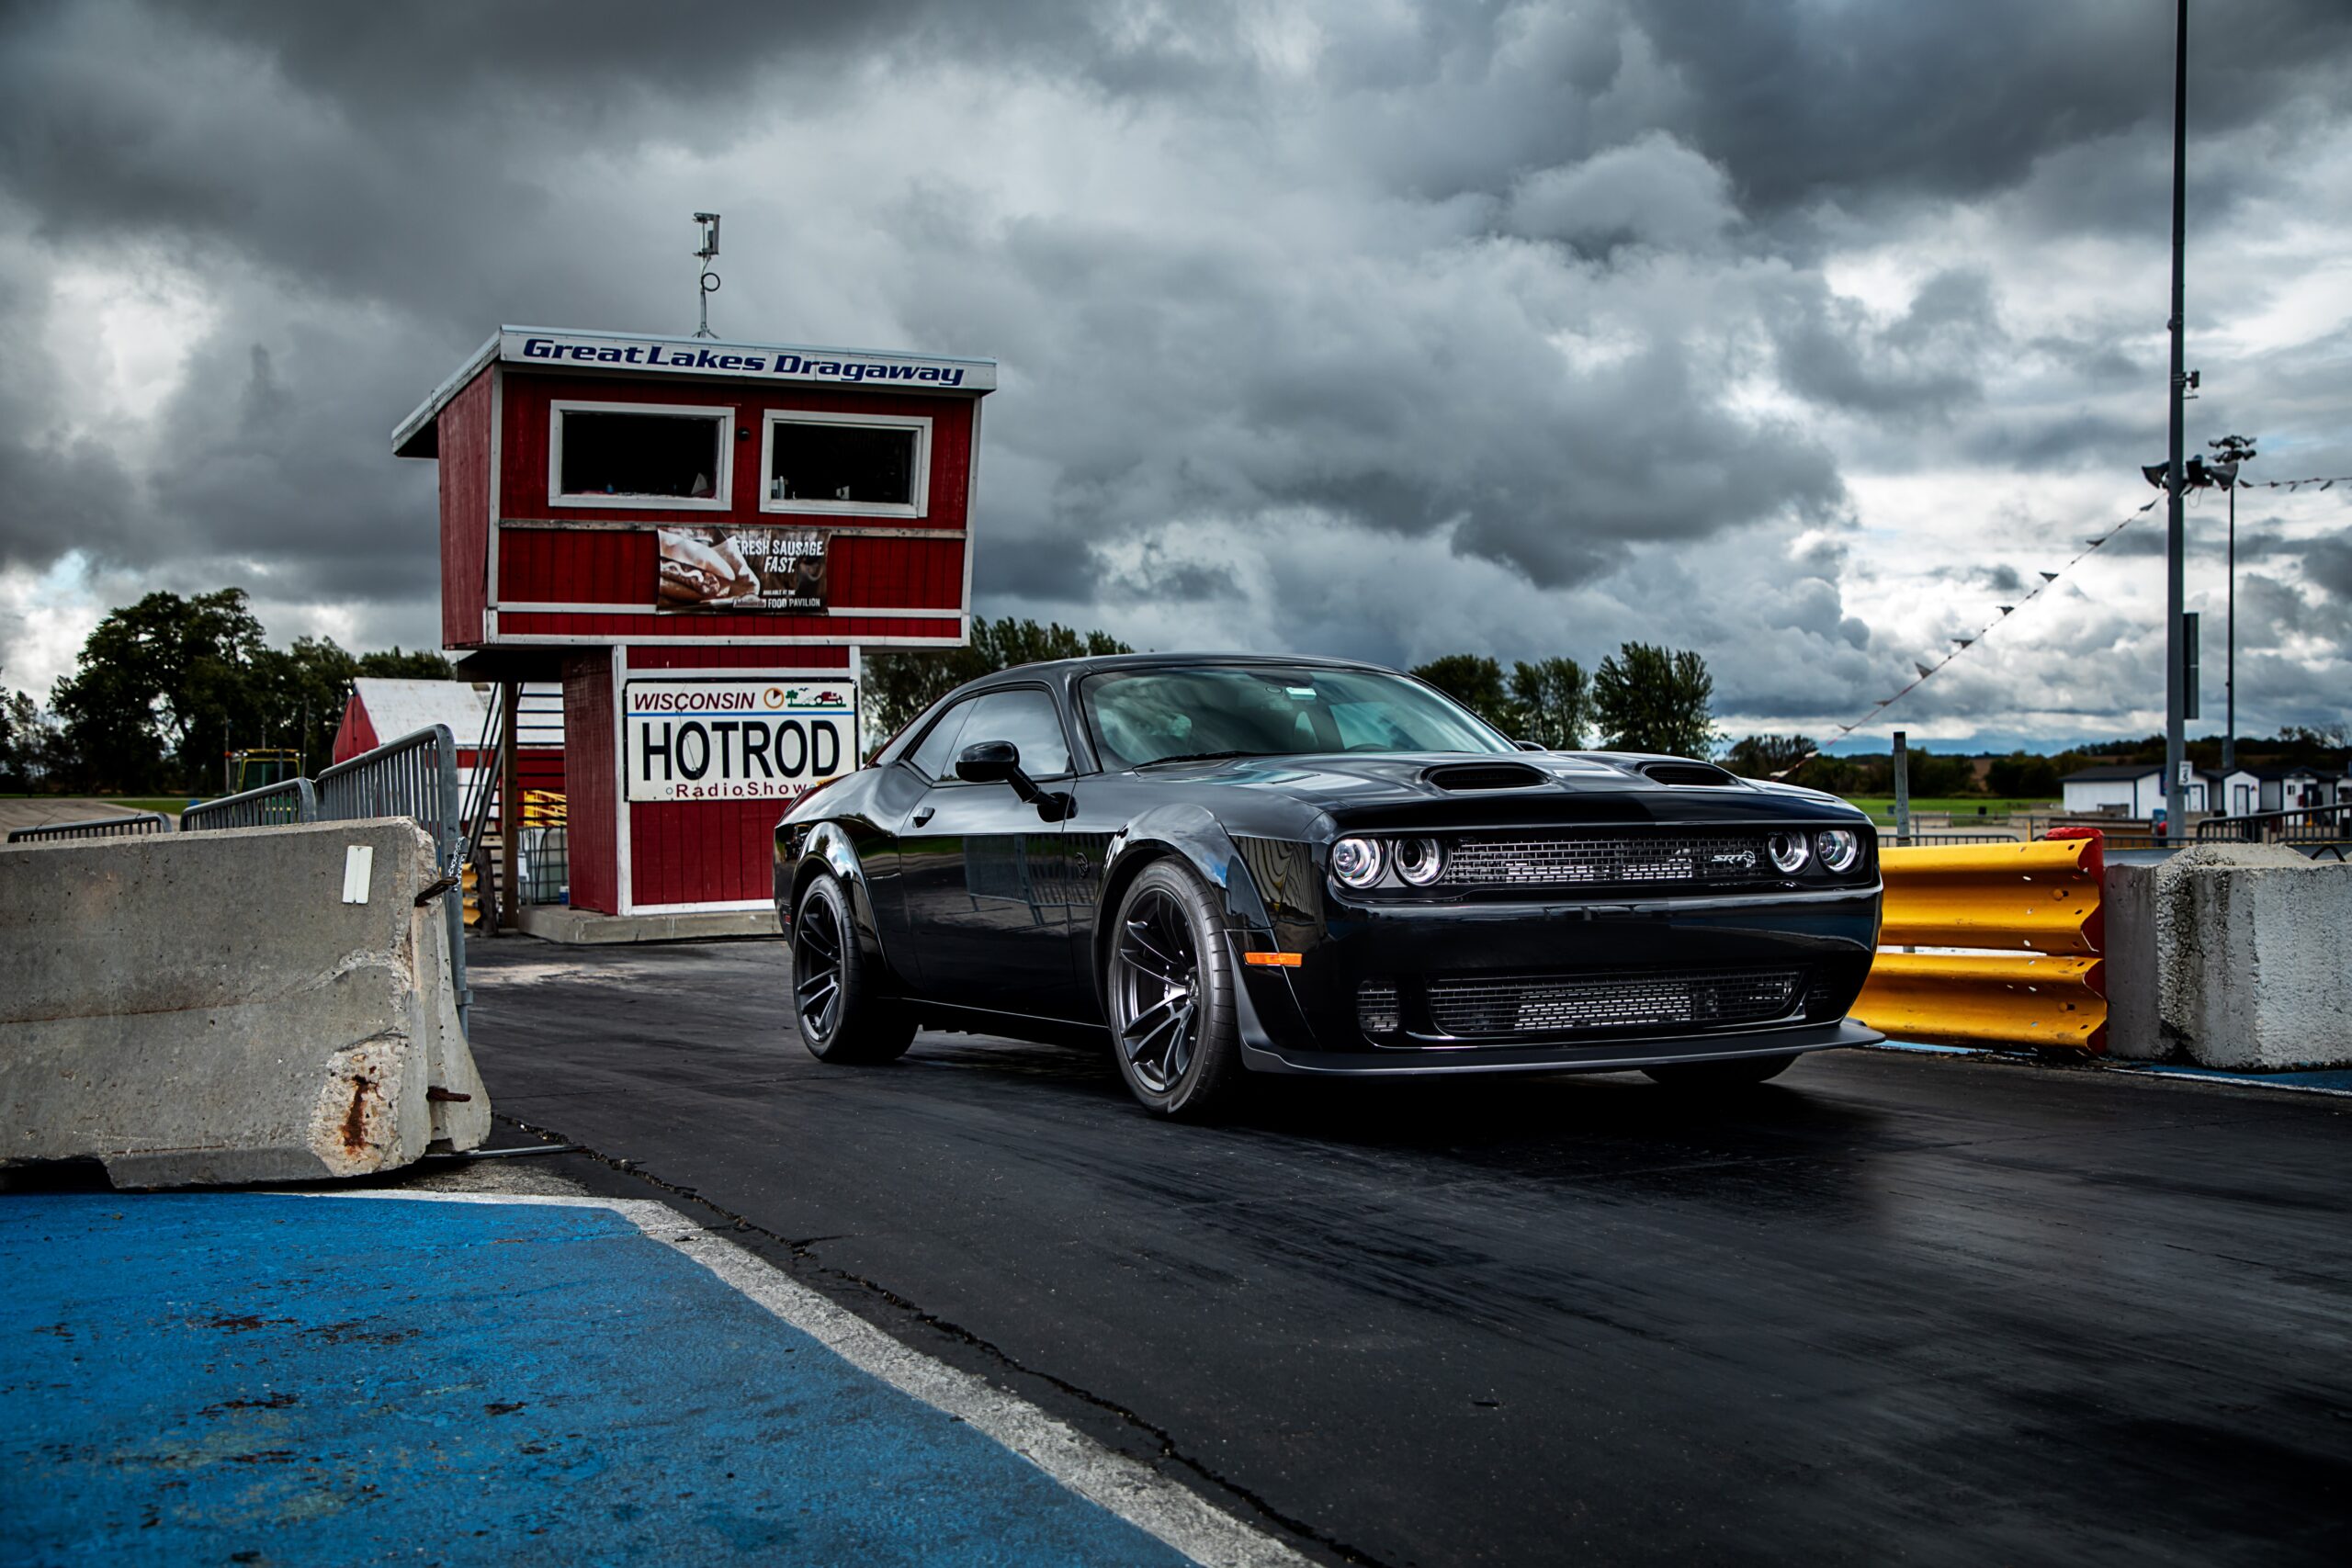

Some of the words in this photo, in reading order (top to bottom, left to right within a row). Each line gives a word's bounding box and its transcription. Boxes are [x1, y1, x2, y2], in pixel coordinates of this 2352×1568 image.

[523, 338, 644, 364] Great
[646, 346, 766, 371] Lakes
[774, 355, 965, 386] Dragaway
[773, 540, 824, 557] SAUSAGE.
[764, 556, 797, 573] FAST.
[768, 598, 787, 608] FOOD
[789, 598, 820, 607] PAVILION
[634, 692, 755, 710] WISCONSIN
[641, 719, 841, 781] HOTROD
[1711, 854, 1747, 864] SRT
